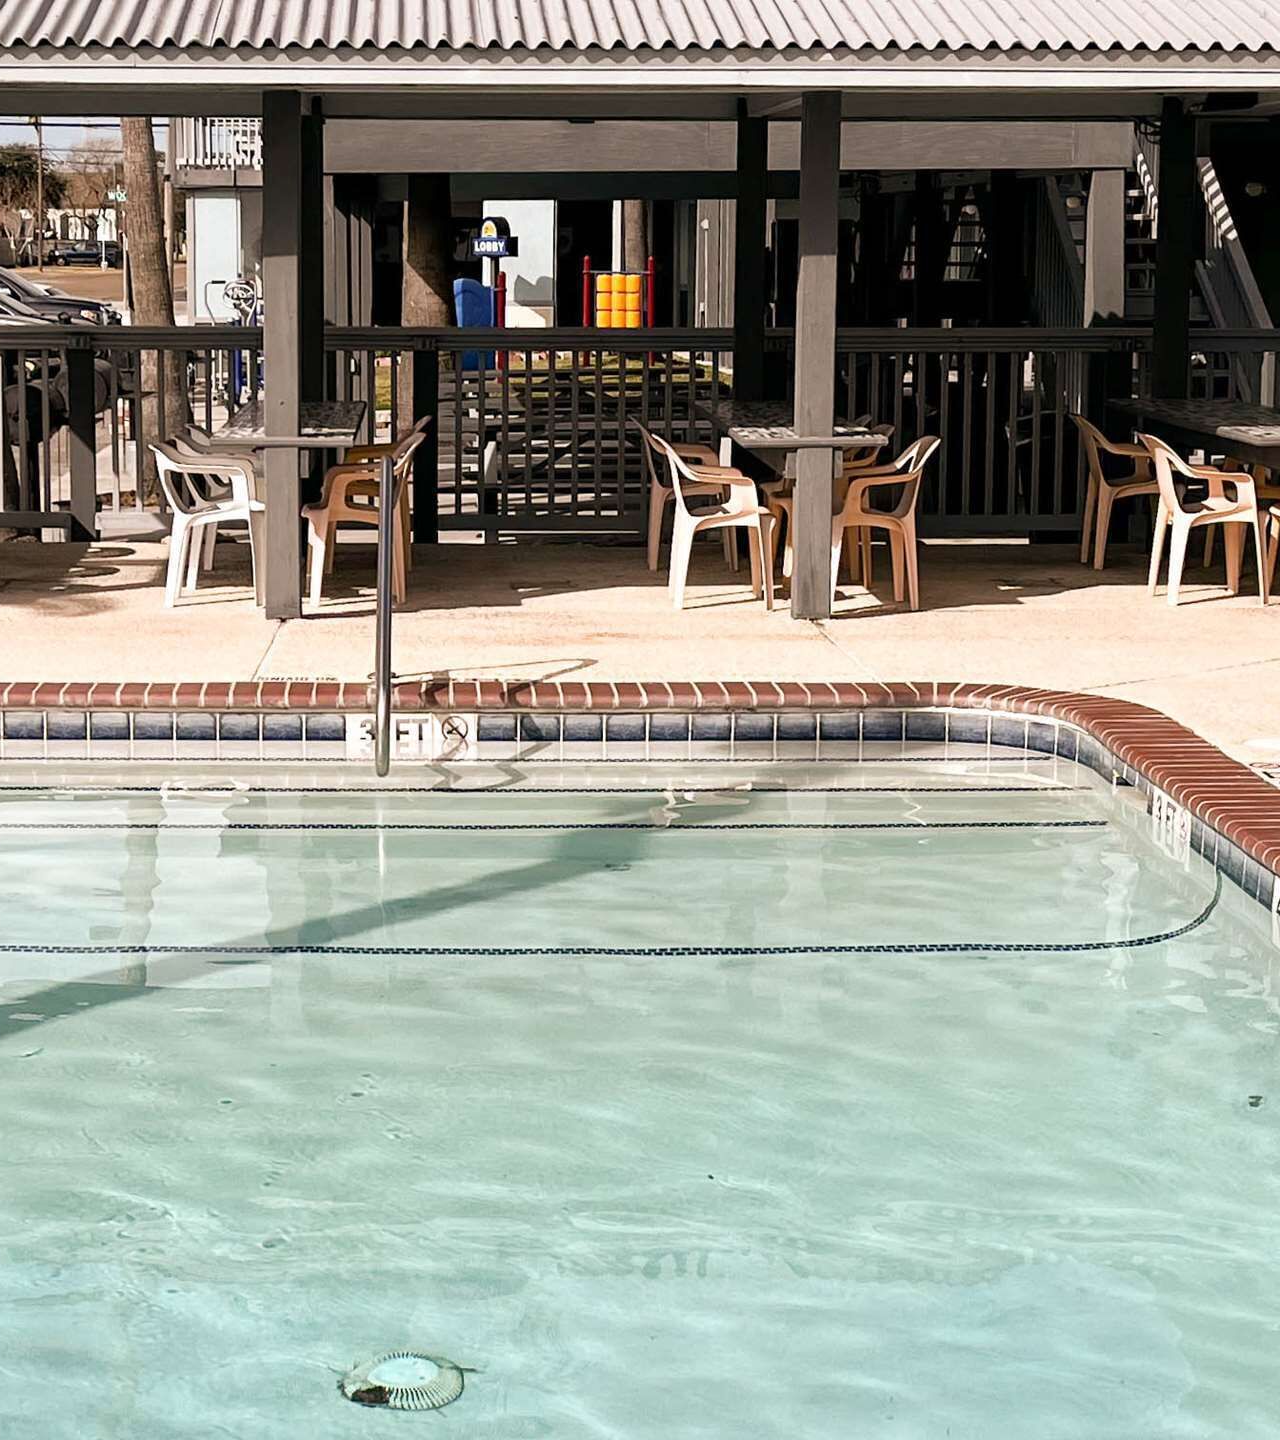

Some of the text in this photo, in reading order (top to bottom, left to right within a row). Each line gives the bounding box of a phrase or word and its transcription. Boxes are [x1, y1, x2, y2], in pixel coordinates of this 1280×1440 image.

[473, 240, 505, 252] LOBBY
[360, 718, 429, 741] 3 FT
